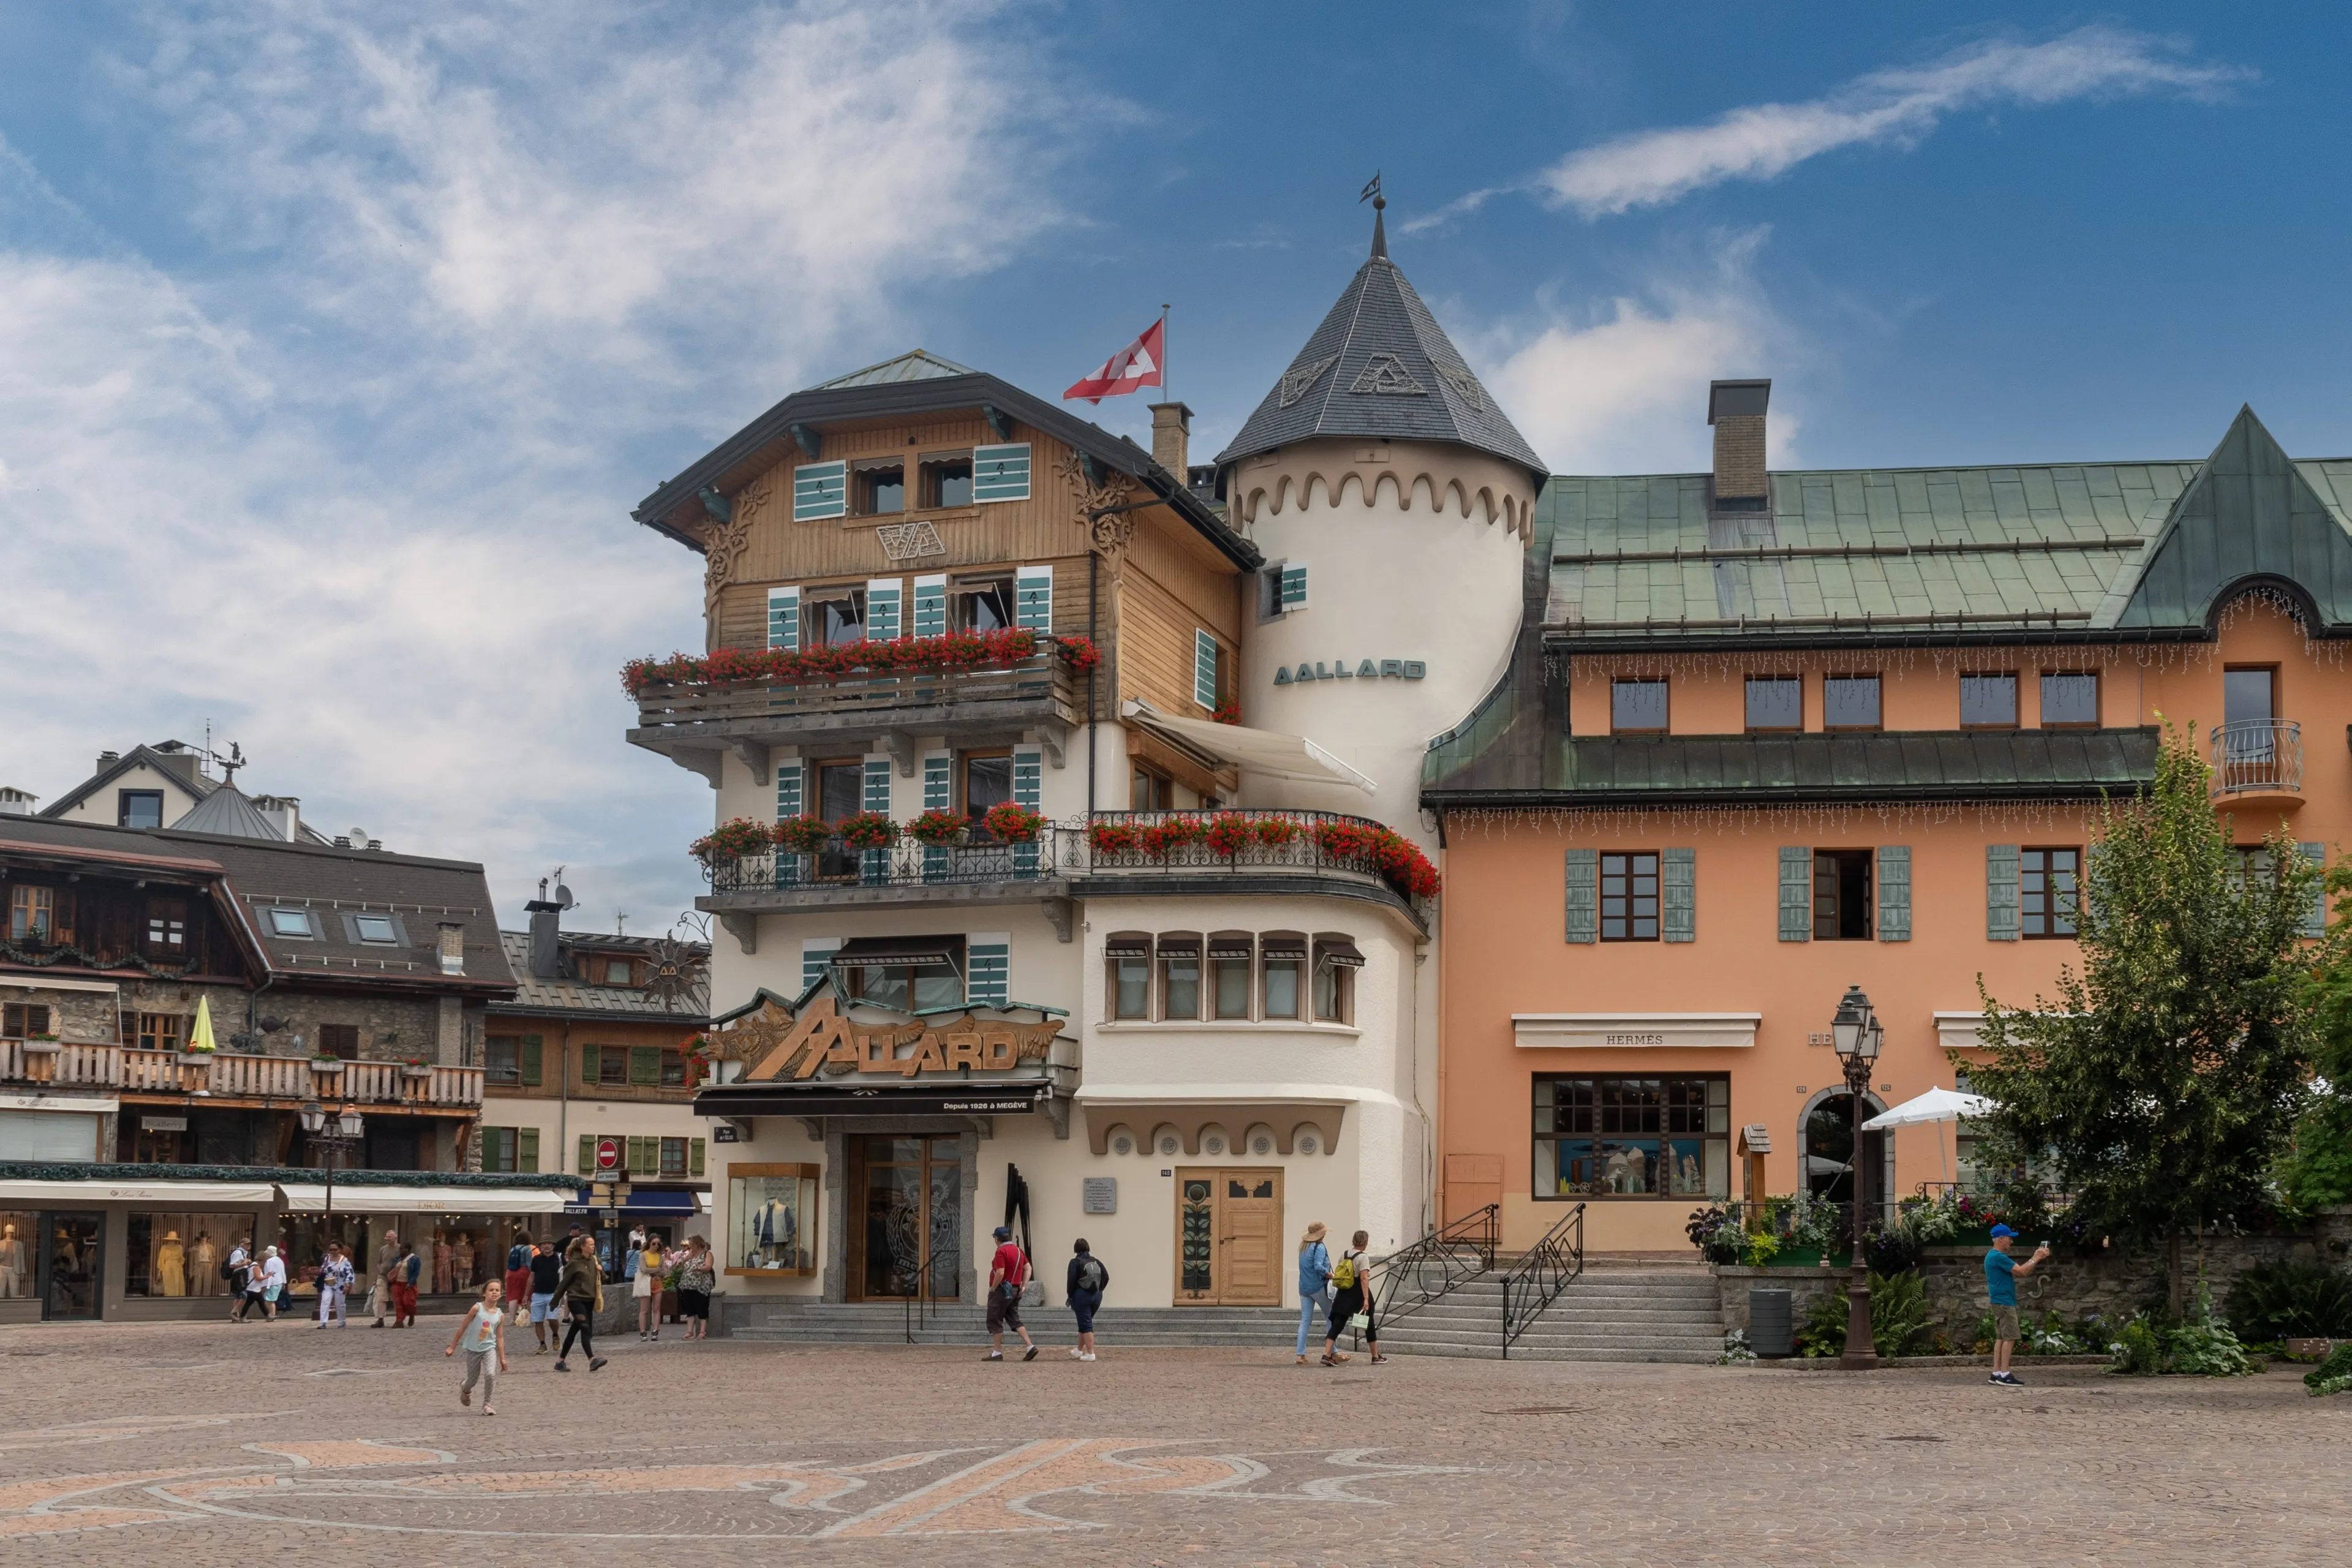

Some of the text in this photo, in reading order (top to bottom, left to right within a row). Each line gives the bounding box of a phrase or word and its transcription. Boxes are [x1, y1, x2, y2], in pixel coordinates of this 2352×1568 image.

[1273, 659, 1426, 685] AALLARD
[1607, 1034, 1663, 1045] HERMÈS
[417, 1201, 445, 1210] DIOR
